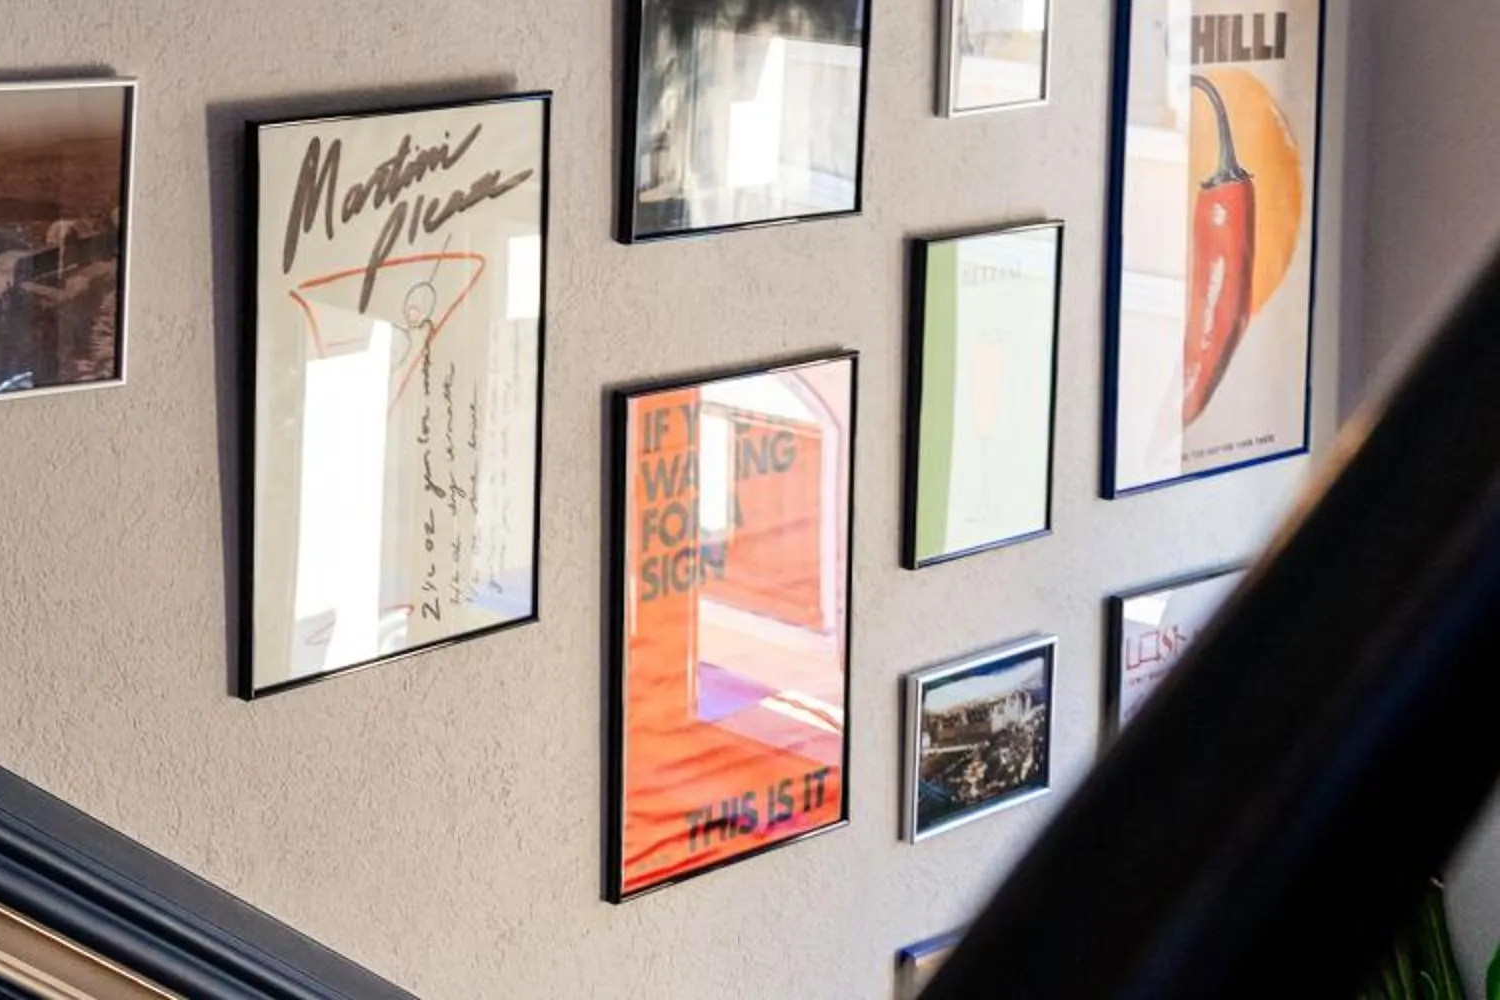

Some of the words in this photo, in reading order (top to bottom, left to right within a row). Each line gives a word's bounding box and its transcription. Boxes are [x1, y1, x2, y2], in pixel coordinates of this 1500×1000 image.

[1164, 11, 1288, 65] HILLI
[642, 408, 670, 454] IF
[640, 429, 797, 502] WAING
[640, 541, 729, 602] SIGN
[684, 791, 758, 853] THIS
[766, 778, 798, 831] IS
[803, 765, 830, 809] IT
